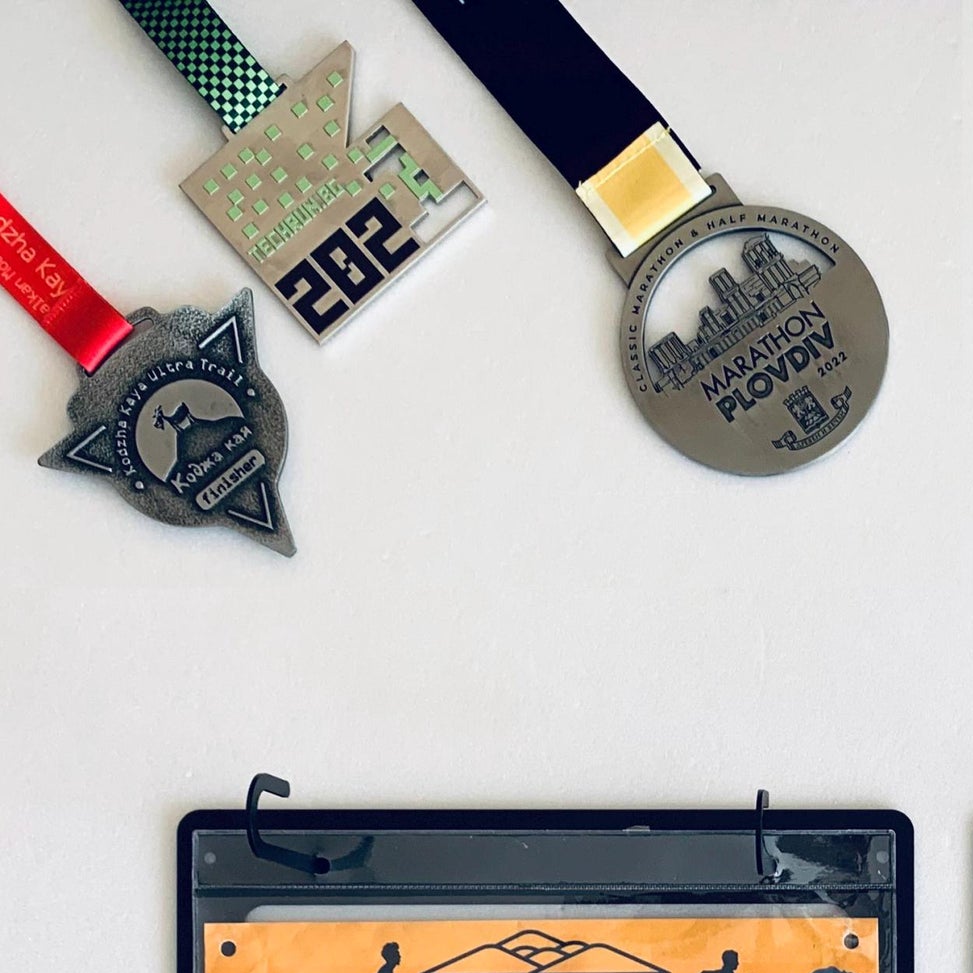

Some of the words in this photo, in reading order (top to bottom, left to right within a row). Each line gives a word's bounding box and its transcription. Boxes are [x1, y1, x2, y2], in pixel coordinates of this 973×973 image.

[706, 212, 747, 231] HALF
[756, 212, 840, 255] MARATHON
[633, 238, 685, 315] MARATHON
[630, 324, 648, 393] CLASSIC
[700, 300, 826, 402] MARATHON
[715, 320, 835, 423] PLOVDIV
[817, 350, 848, 378] 2022
[202, 455, 257, 505] finisher
